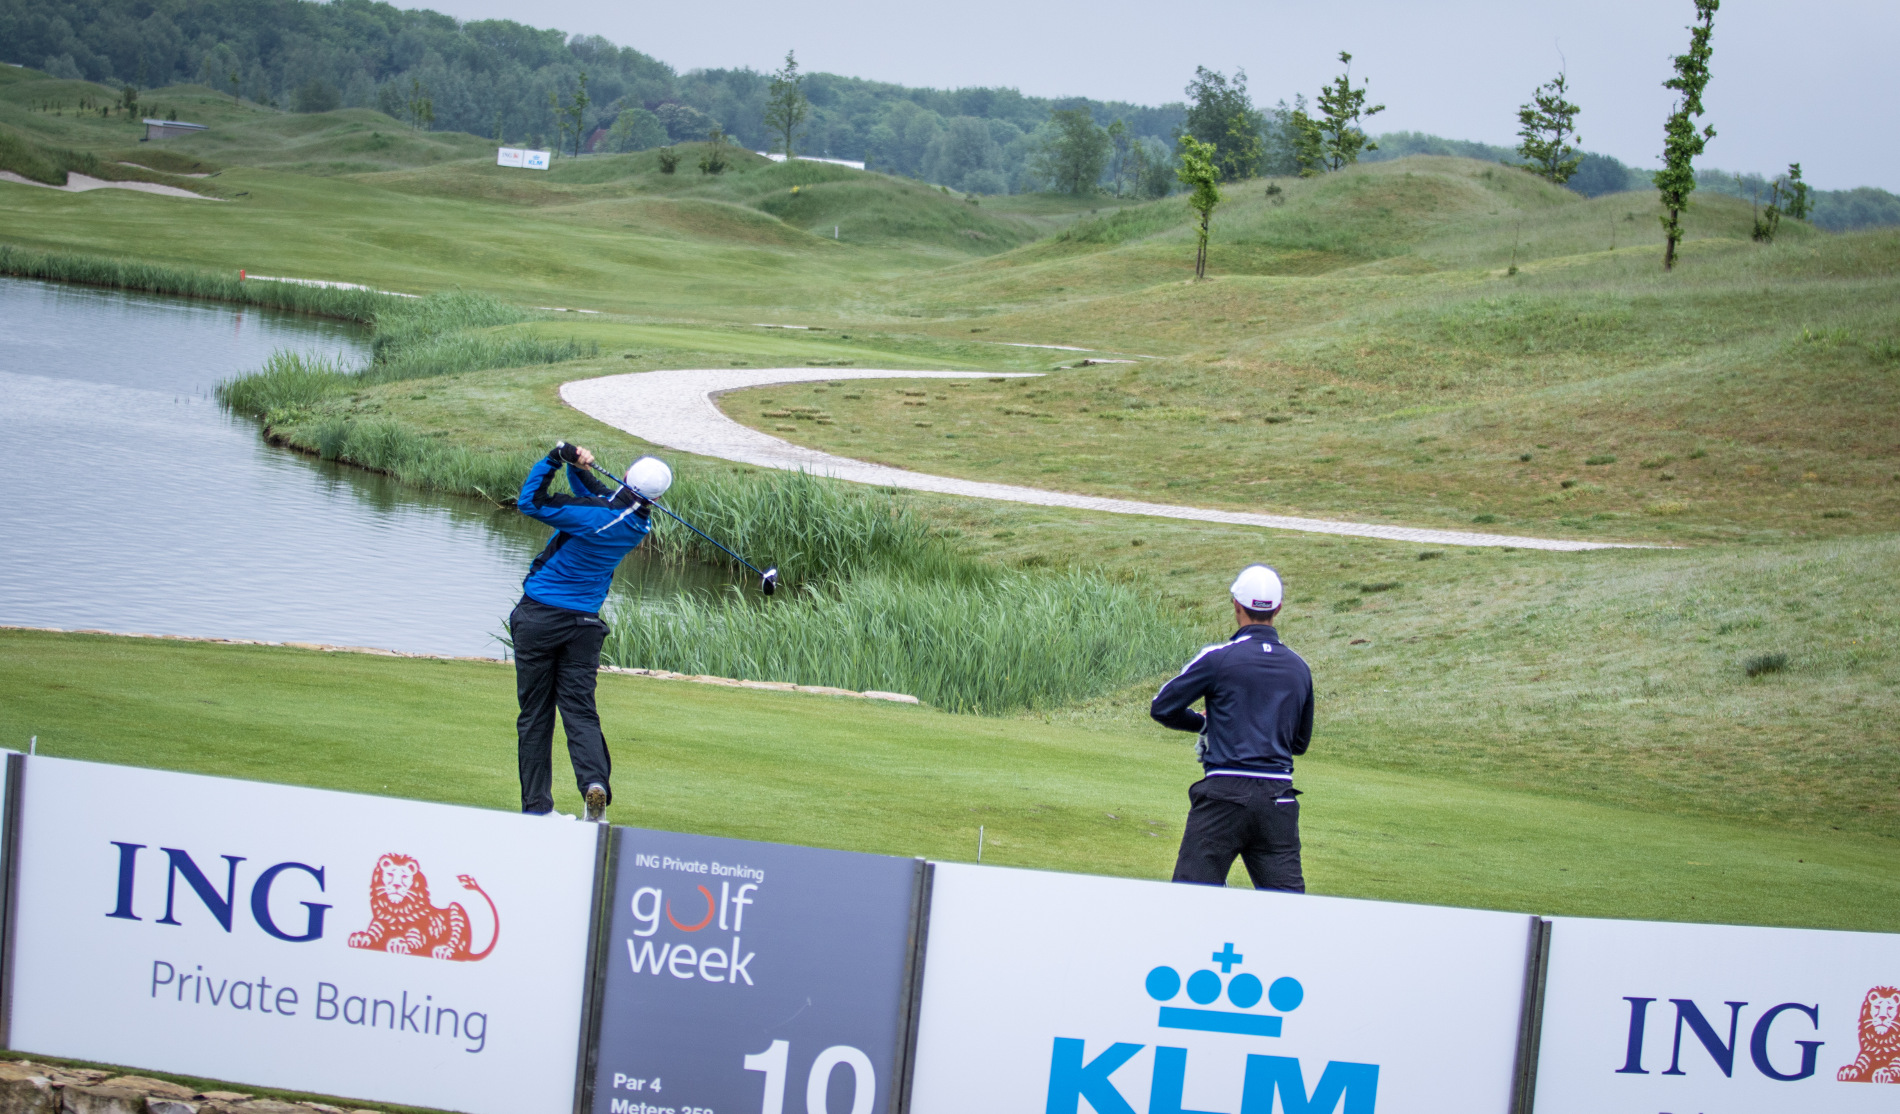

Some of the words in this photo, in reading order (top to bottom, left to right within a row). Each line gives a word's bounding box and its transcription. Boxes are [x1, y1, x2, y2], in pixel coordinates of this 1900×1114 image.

[105, 840, 334, 943] ING
[635, 853, 660, 869] ING
[662, 855, 708, 874] Private
[711, 861, 764, 884] Banking
[626, 936, 756, 986] week
[151, 960, 298, 1016] Private
[315, 981, 488, 1053] Banking
[1614, 996, 1826, 1082] ING
[610, 1098, 676, 1114] Meters
[613, 1072, 646, 1091] Par
[649, 1077, 662, 1093] 4
[743, 1039, 876, 1114] 10
[1045, 1036, 1380, 1114] KLM
